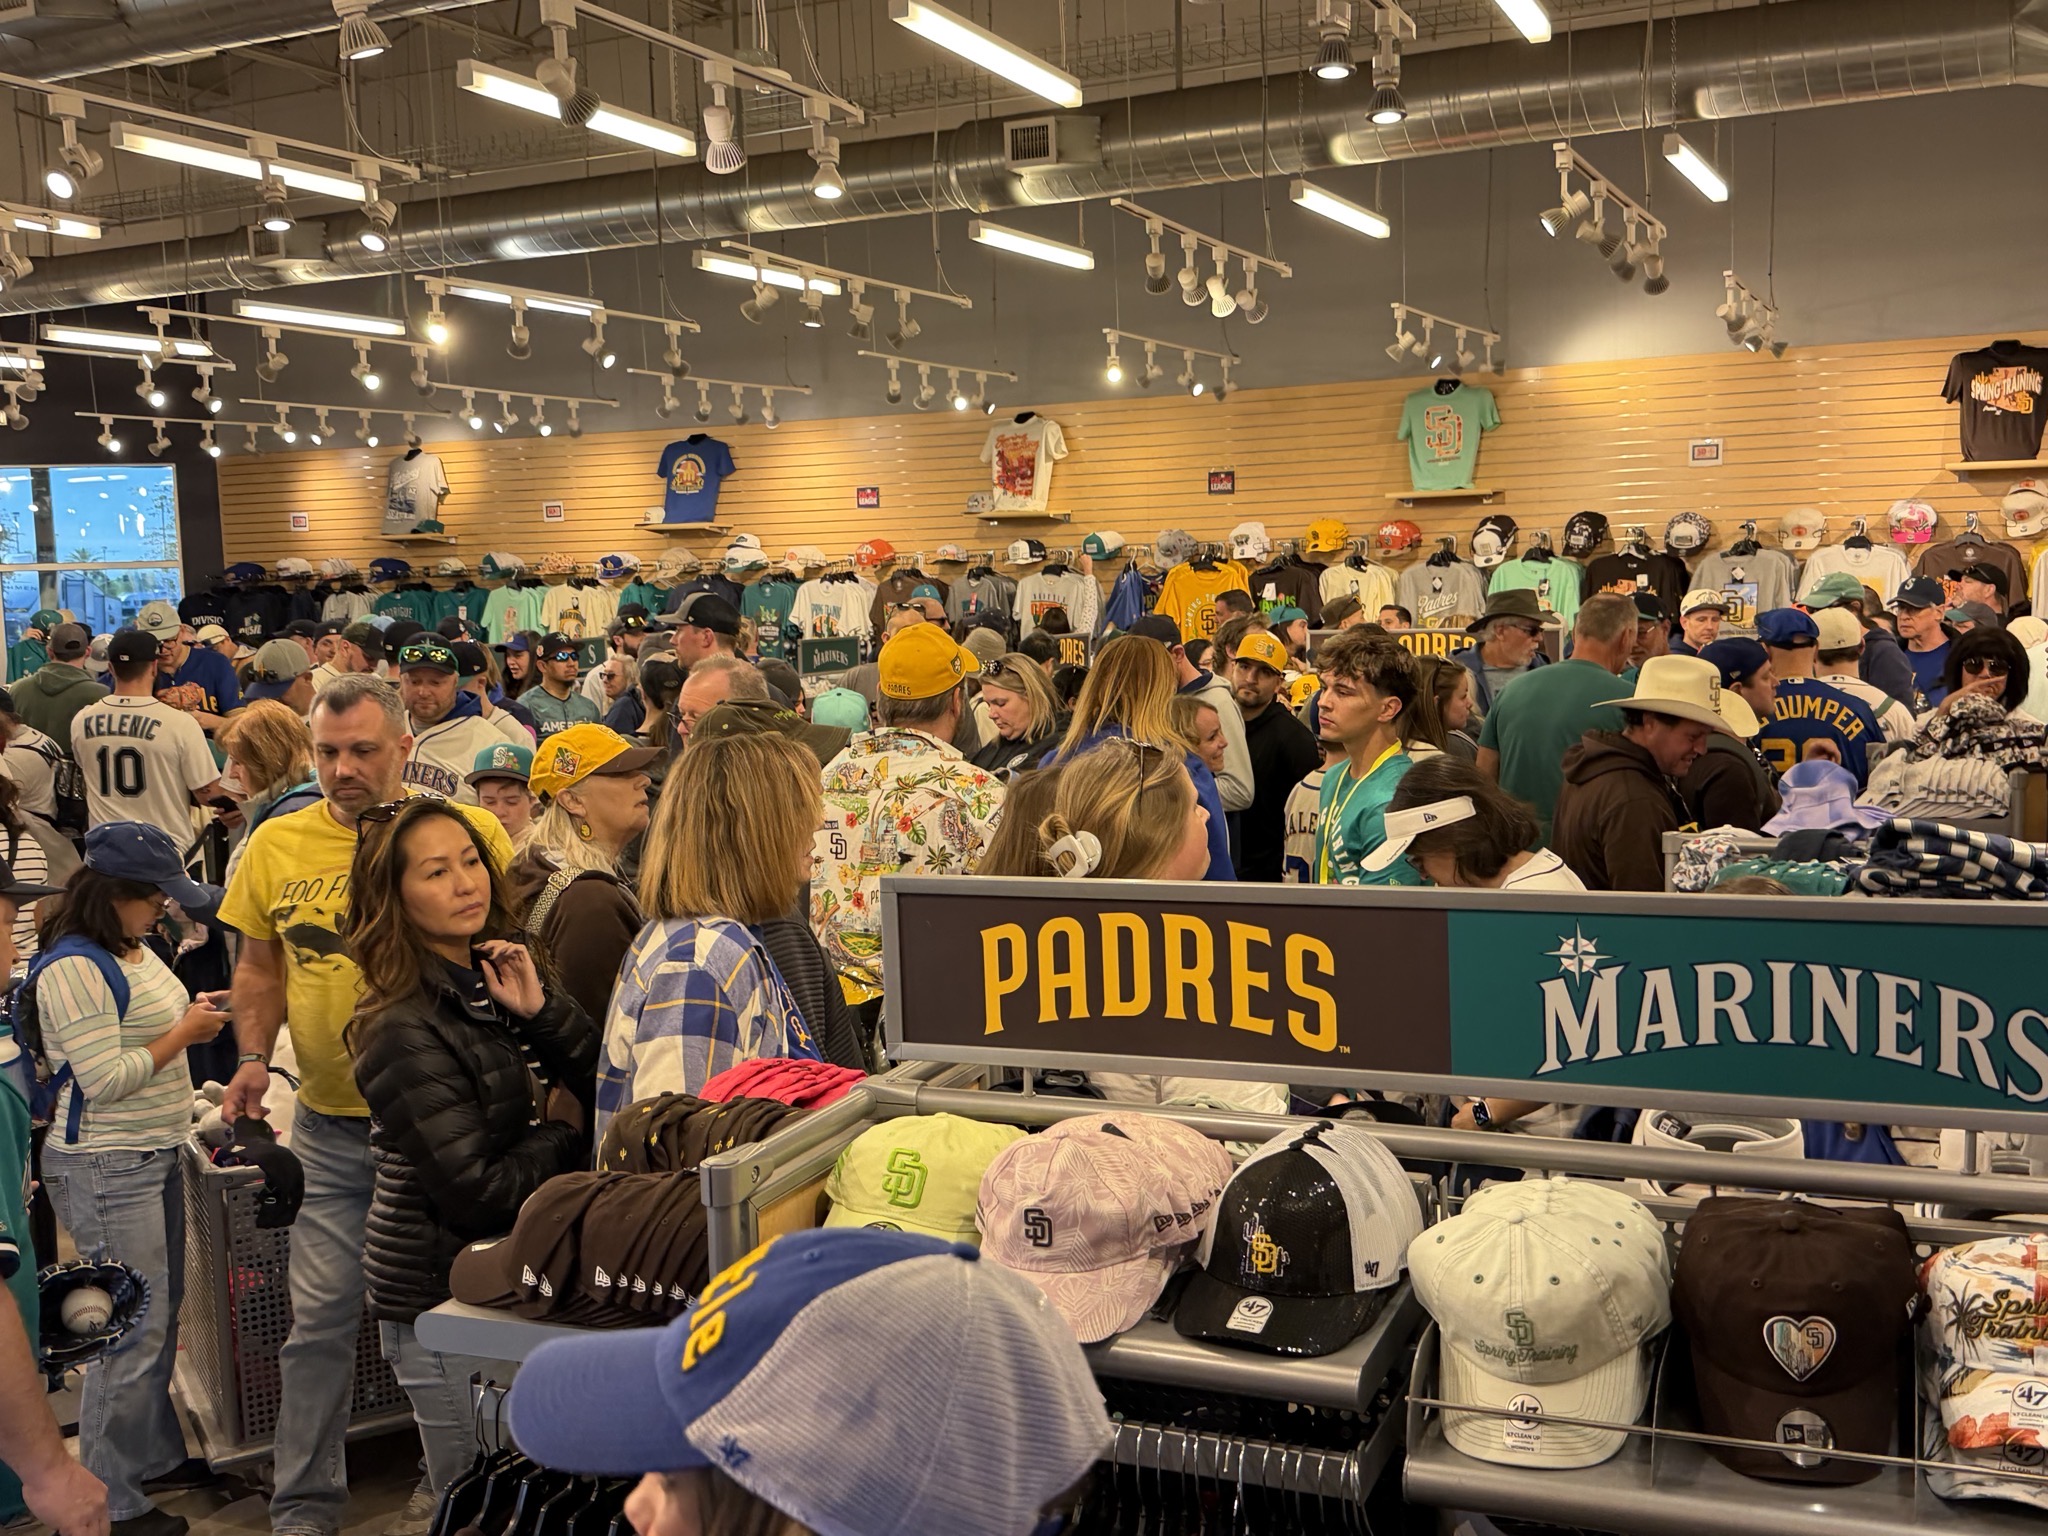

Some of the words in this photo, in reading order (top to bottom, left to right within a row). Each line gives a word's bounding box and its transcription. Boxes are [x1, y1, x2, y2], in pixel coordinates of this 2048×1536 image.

[1425, 405, 1463, 458] SD
[1904, 577, 1916, 590] S
[1418, 591, 1458, 614] Padres
[588, 644, 596, 664] S
[813, 650, 849, 669] MARINERS
[887, 683, 912, 696] PADRES
[84, 713, 162, 742] KELENIC
[1775, 694, 1864, 742] DUMPER
[96, 744, 147, 798] 10
[830, 832, 847, 860] SD
[277, 878, 323, 907] FOO
[979, 911, 1338, 1054] PADRES
[1533, 960, 2048, 1103] MARINERS
[882, 1147, 928, 1209] SD
[1023, 1207, 1053, 1248] SD
[1252, 1233, 1278, 1273] SD
[1505, 1312, 1535, 1346] SD
[1806, 1327, 1825, 1349] SD
[1474, 1338, 1516, 1367] Spring
[1516, 1343, 1579, 1365] Training
